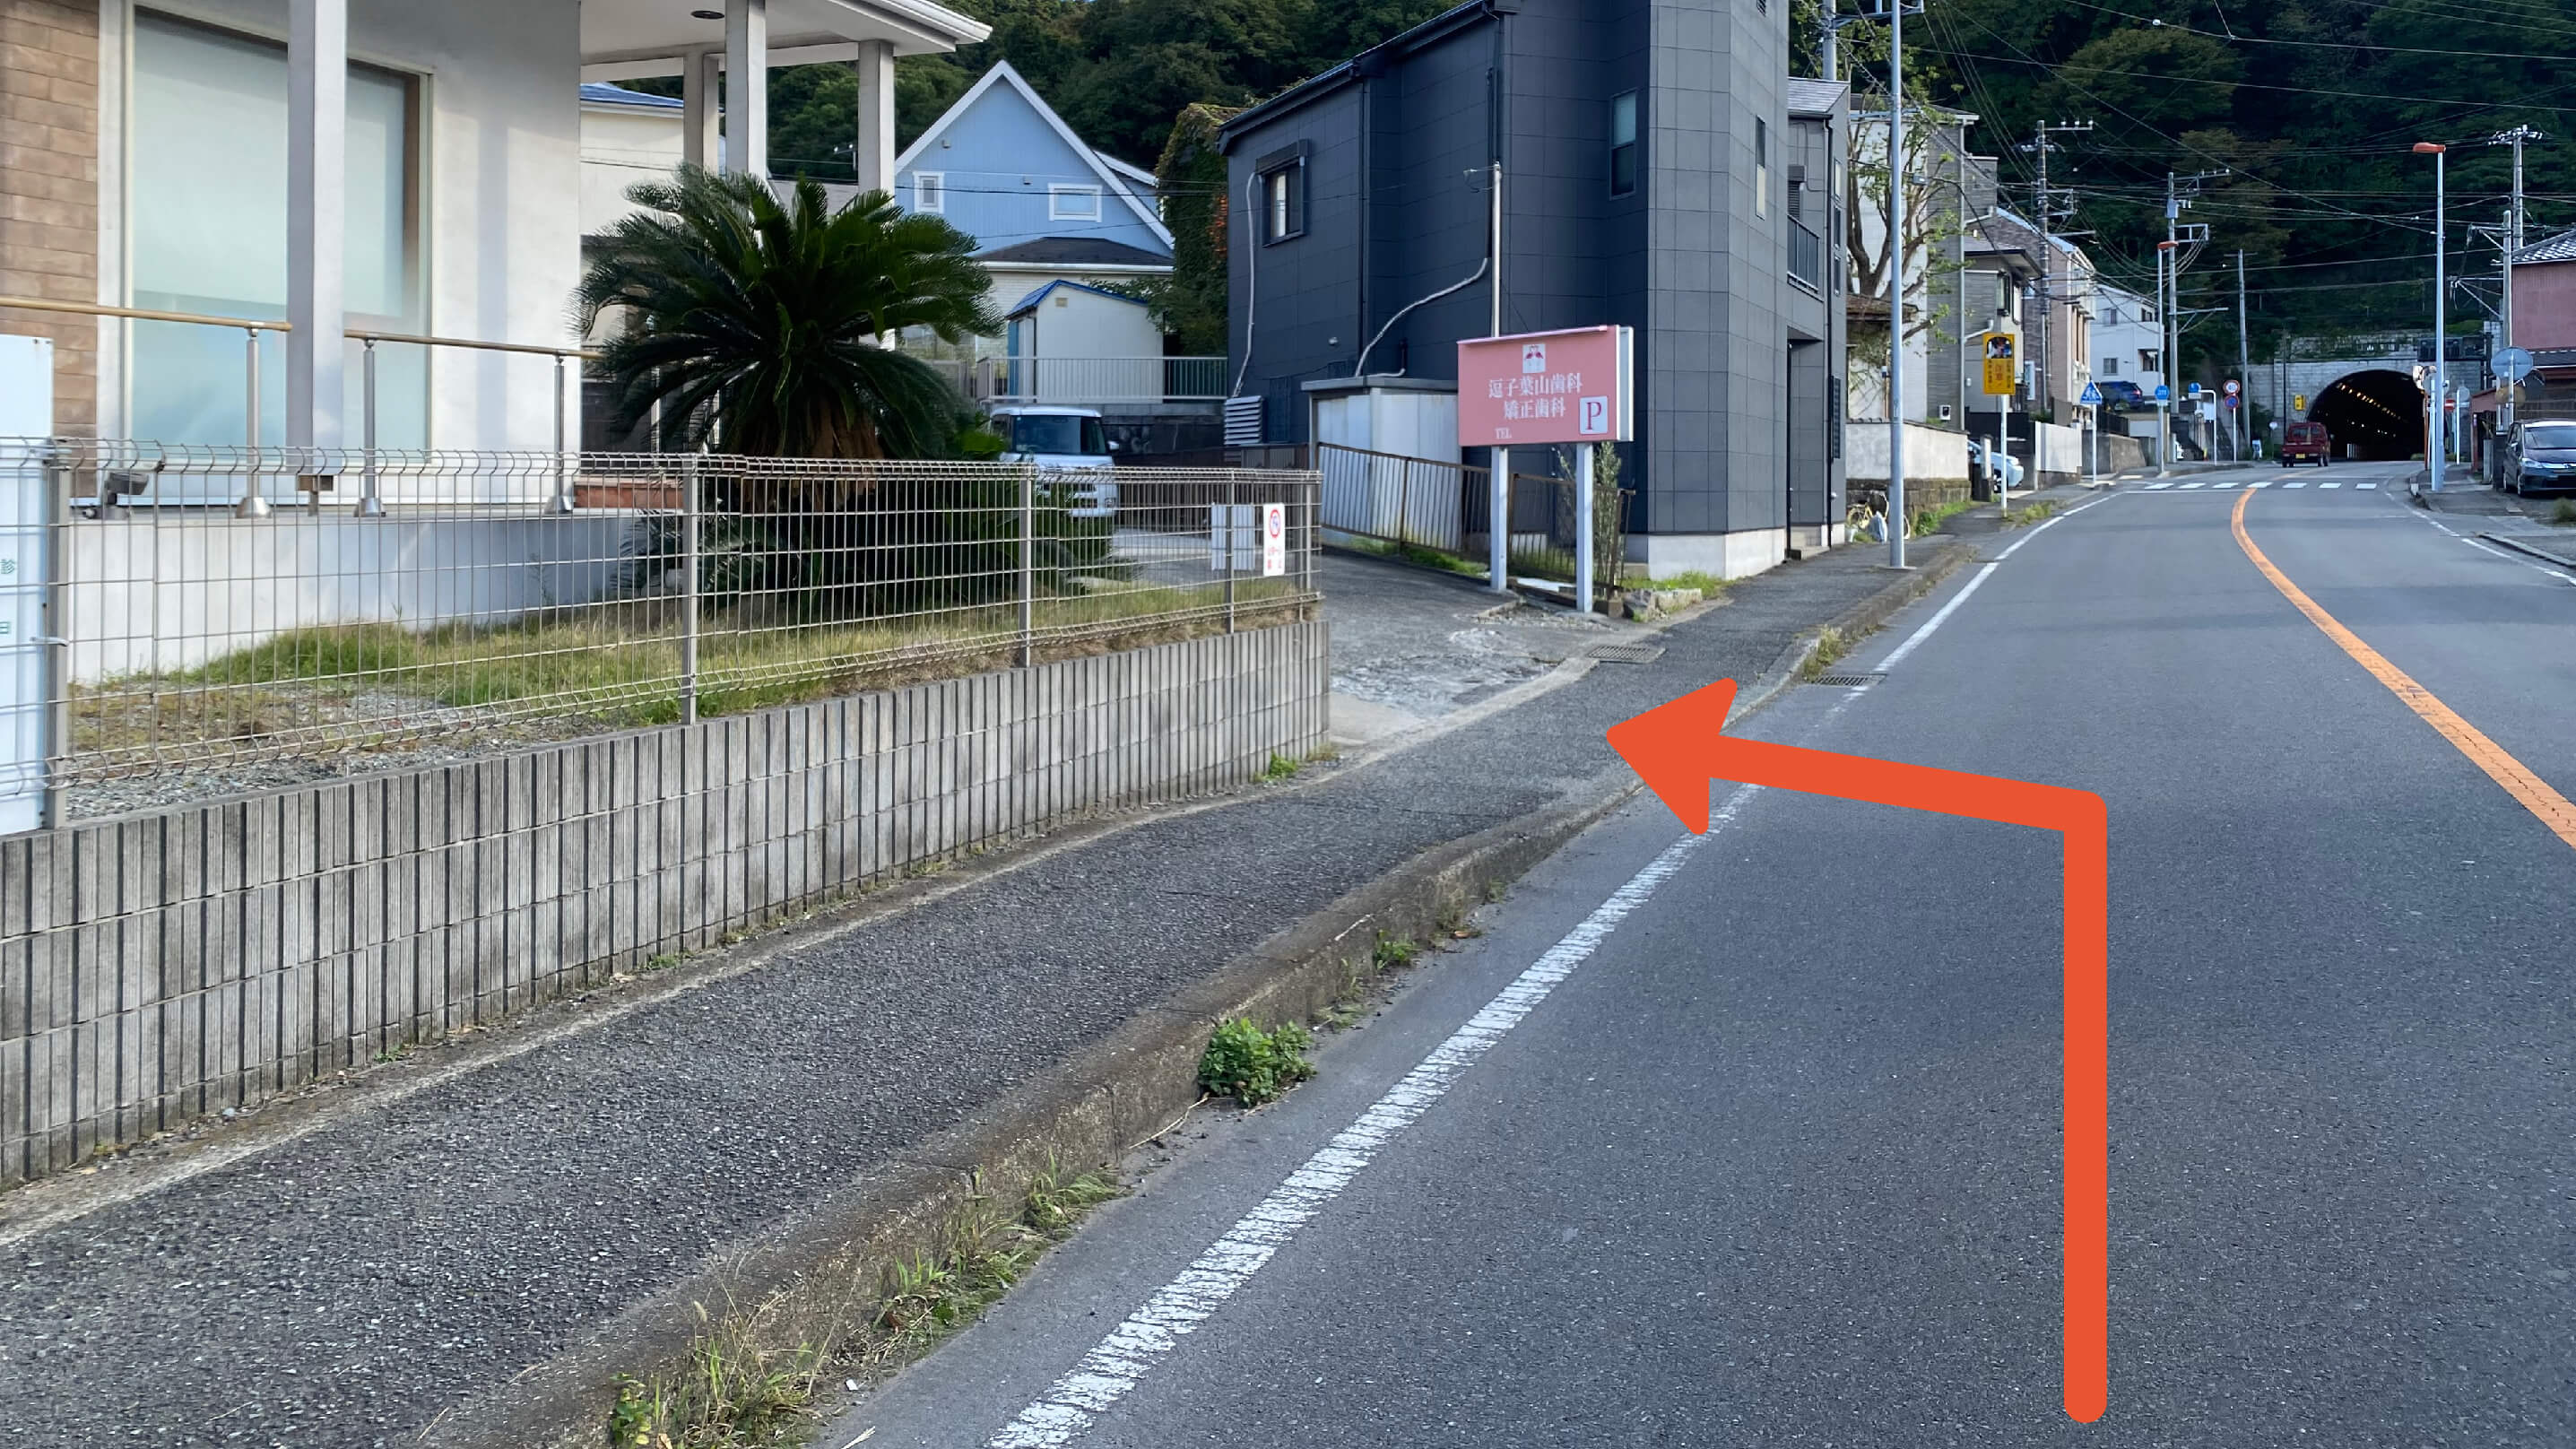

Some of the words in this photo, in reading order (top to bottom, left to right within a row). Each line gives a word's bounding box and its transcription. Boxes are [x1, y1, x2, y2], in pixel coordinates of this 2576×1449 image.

[1488, 372, 1583, 398] 逗子葉山歯科
[1504, 396, 1566, 420] 矯正歯科
[1584, 401, 1601, 430] P
